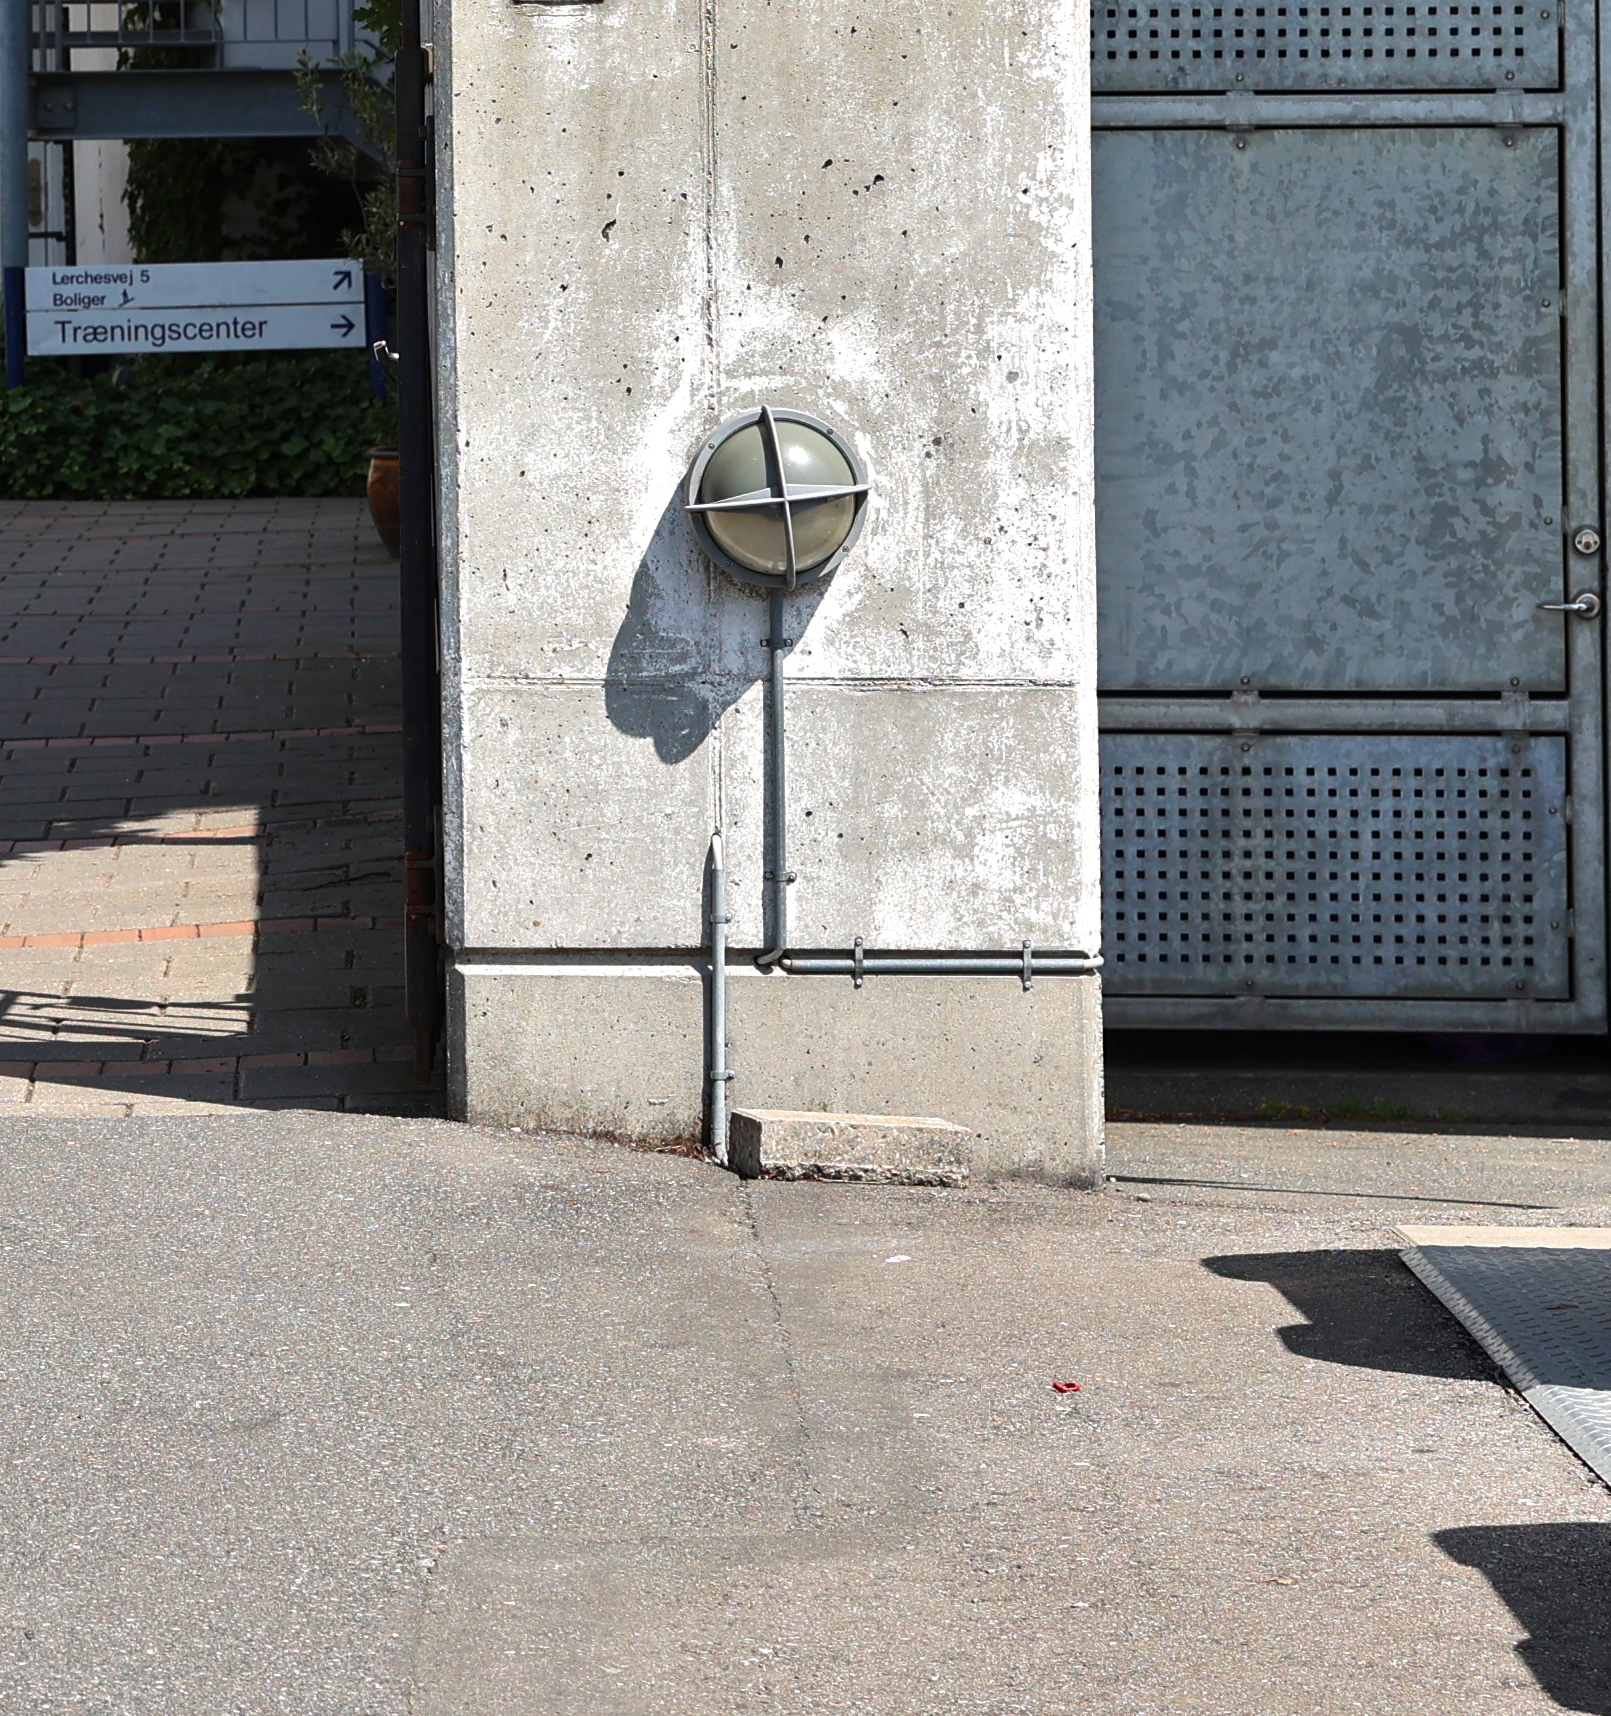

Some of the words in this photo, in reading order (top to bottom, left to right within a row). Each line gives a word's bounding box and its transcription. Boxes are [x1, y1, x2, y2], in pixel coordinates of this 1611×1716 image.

[52, 269, 133, 286] Lerchesvej
[140, 269, 150, 283] 5
[53, 292, 106, 309] Boliger
[54, 317, 268, 347] Træningscenter
